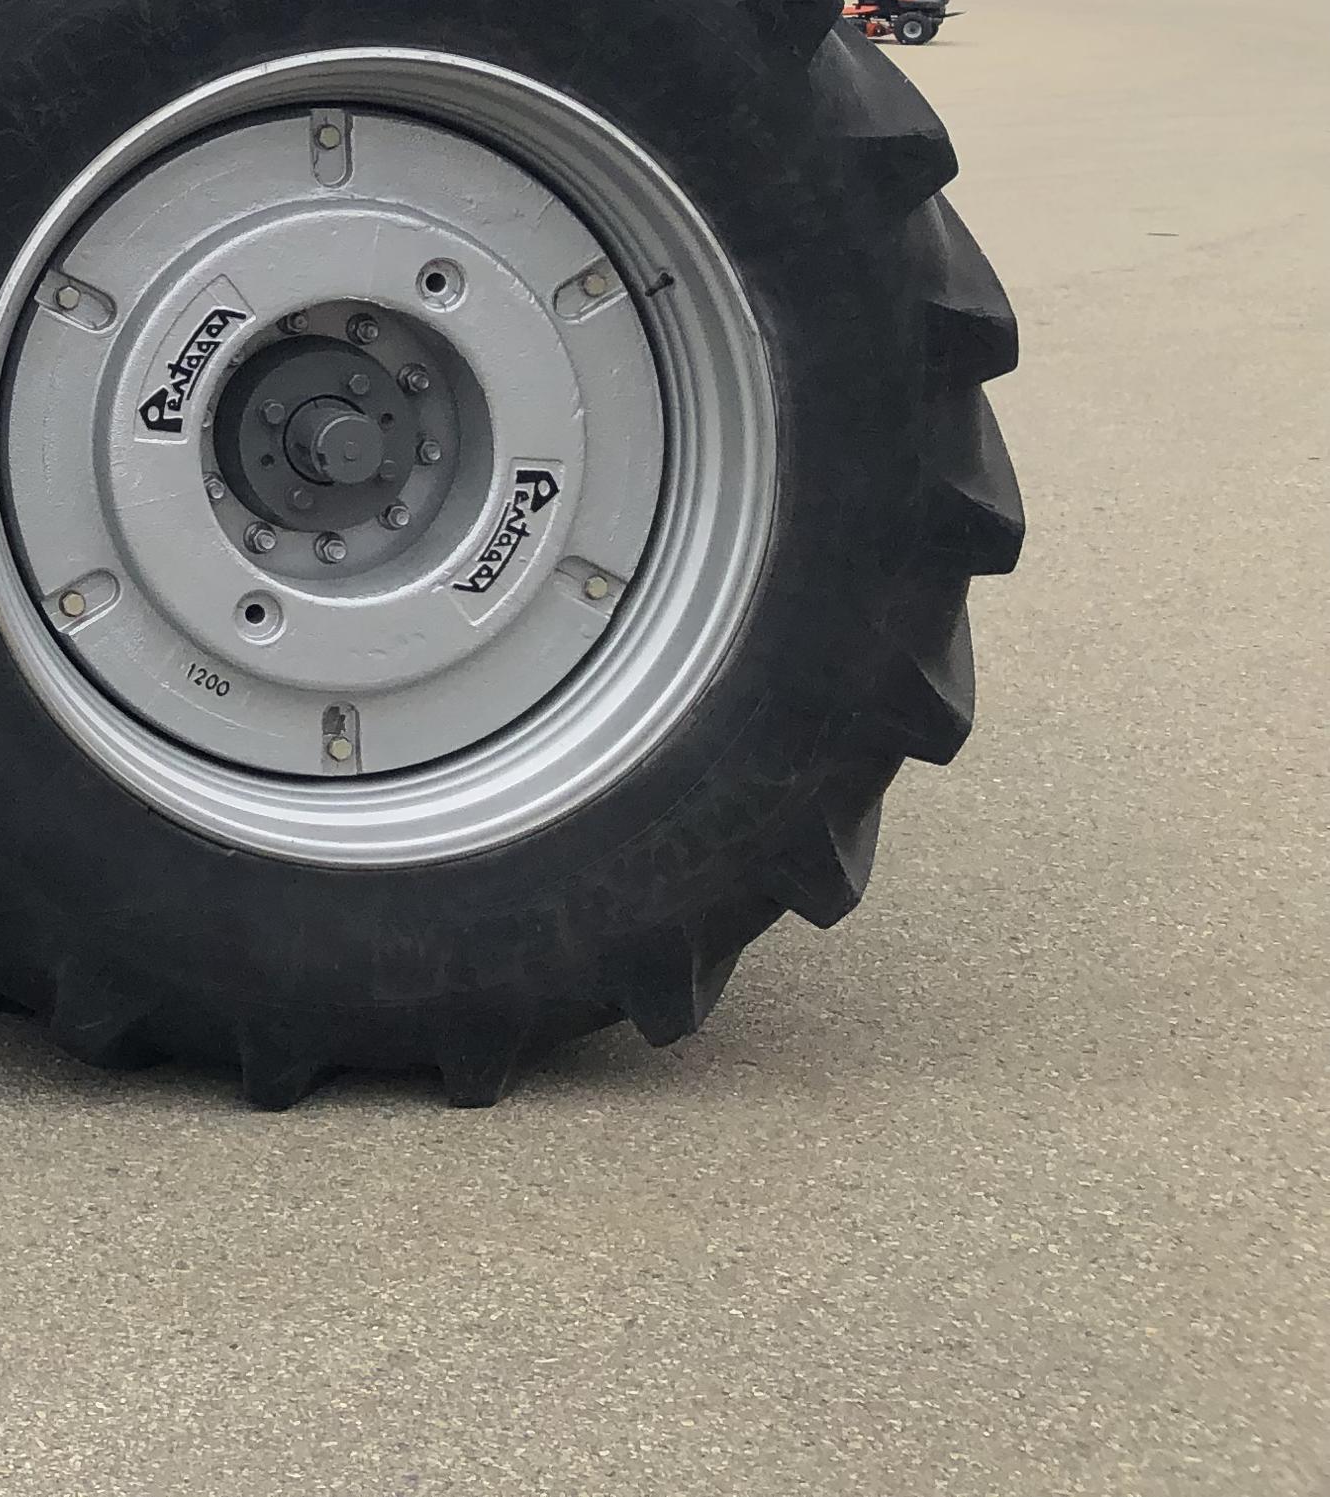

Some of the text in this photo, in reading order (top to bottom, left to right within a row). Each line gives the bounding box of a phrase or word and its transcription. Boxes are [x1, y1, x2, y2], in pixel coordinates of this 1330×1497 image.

[138, 309, 247, 434] Pentagon
[452, 469, 561, 593] Pentagon
[187, 663, 230, 697] 1200
